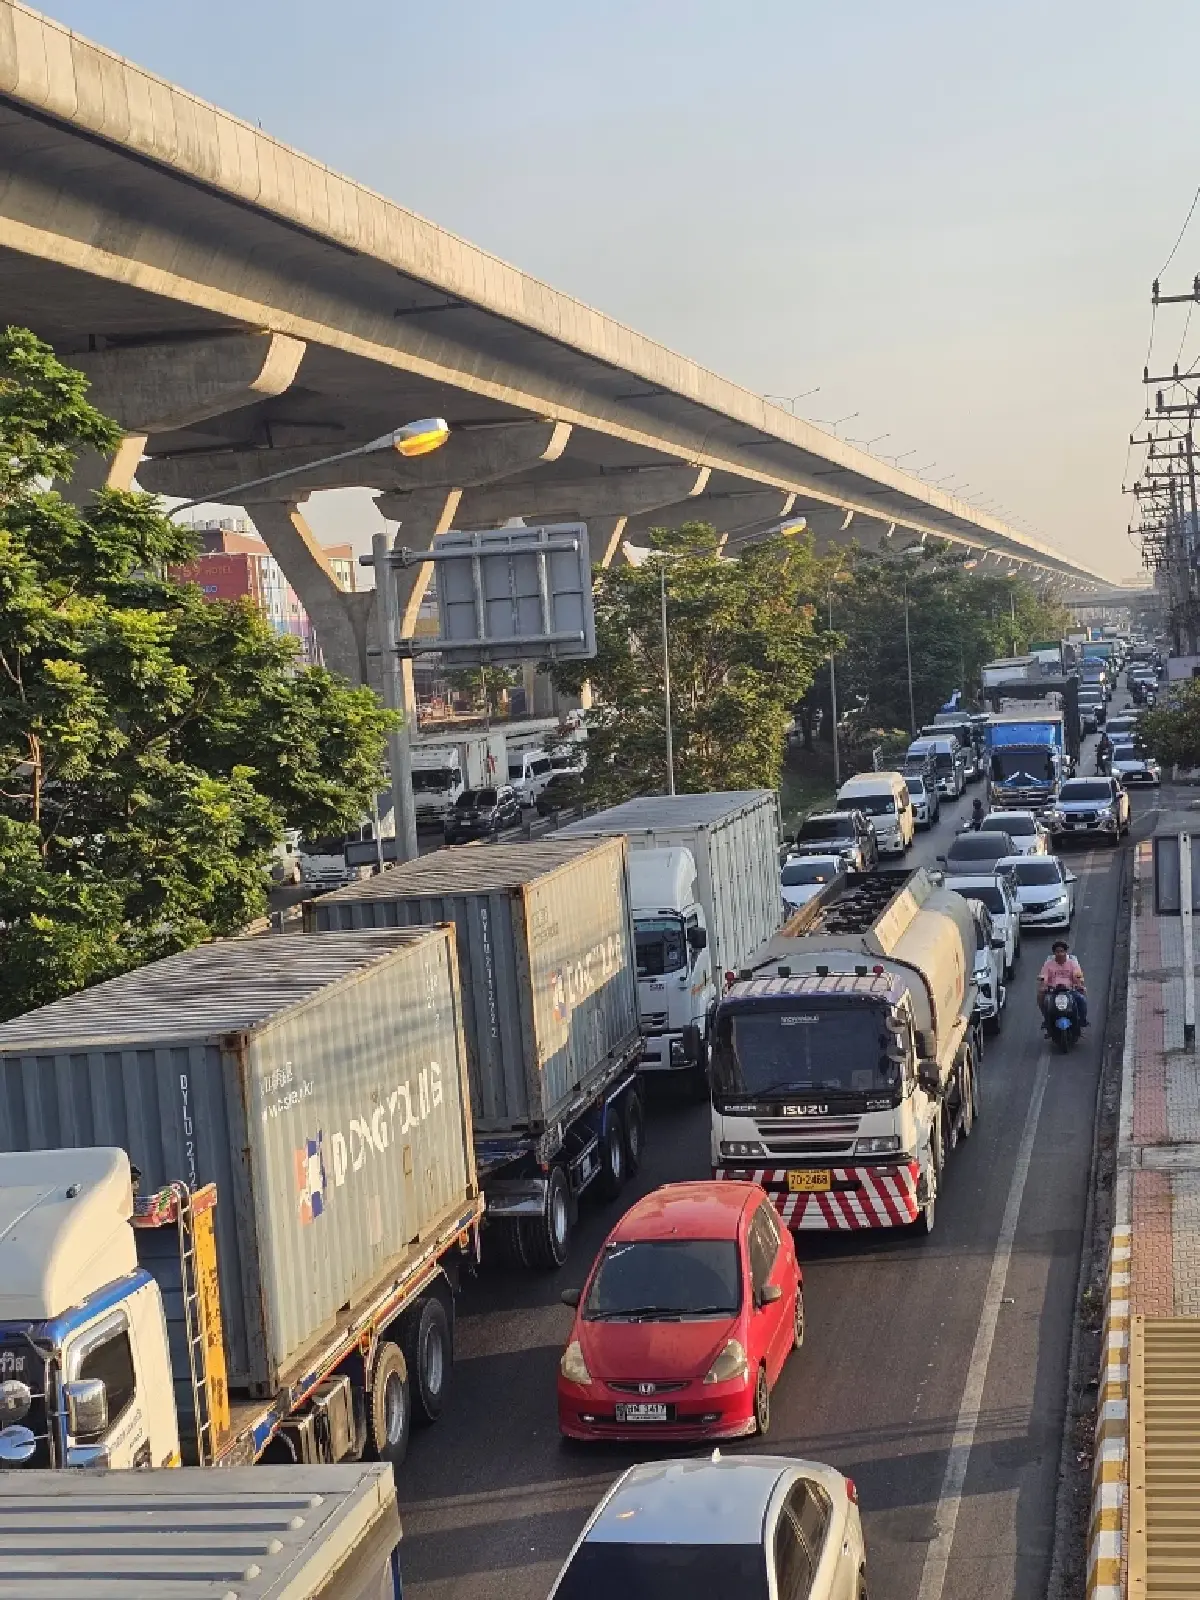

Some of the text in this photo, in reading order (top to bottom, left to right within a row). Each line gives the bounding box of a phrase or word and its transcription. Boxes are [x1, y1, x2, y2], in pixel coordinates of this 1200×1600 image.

[481, 909, 490, 953] DYLU
[180, 1075, 193, 1136] DYLU
[782, 1104, 829, 1115] ISUZU
